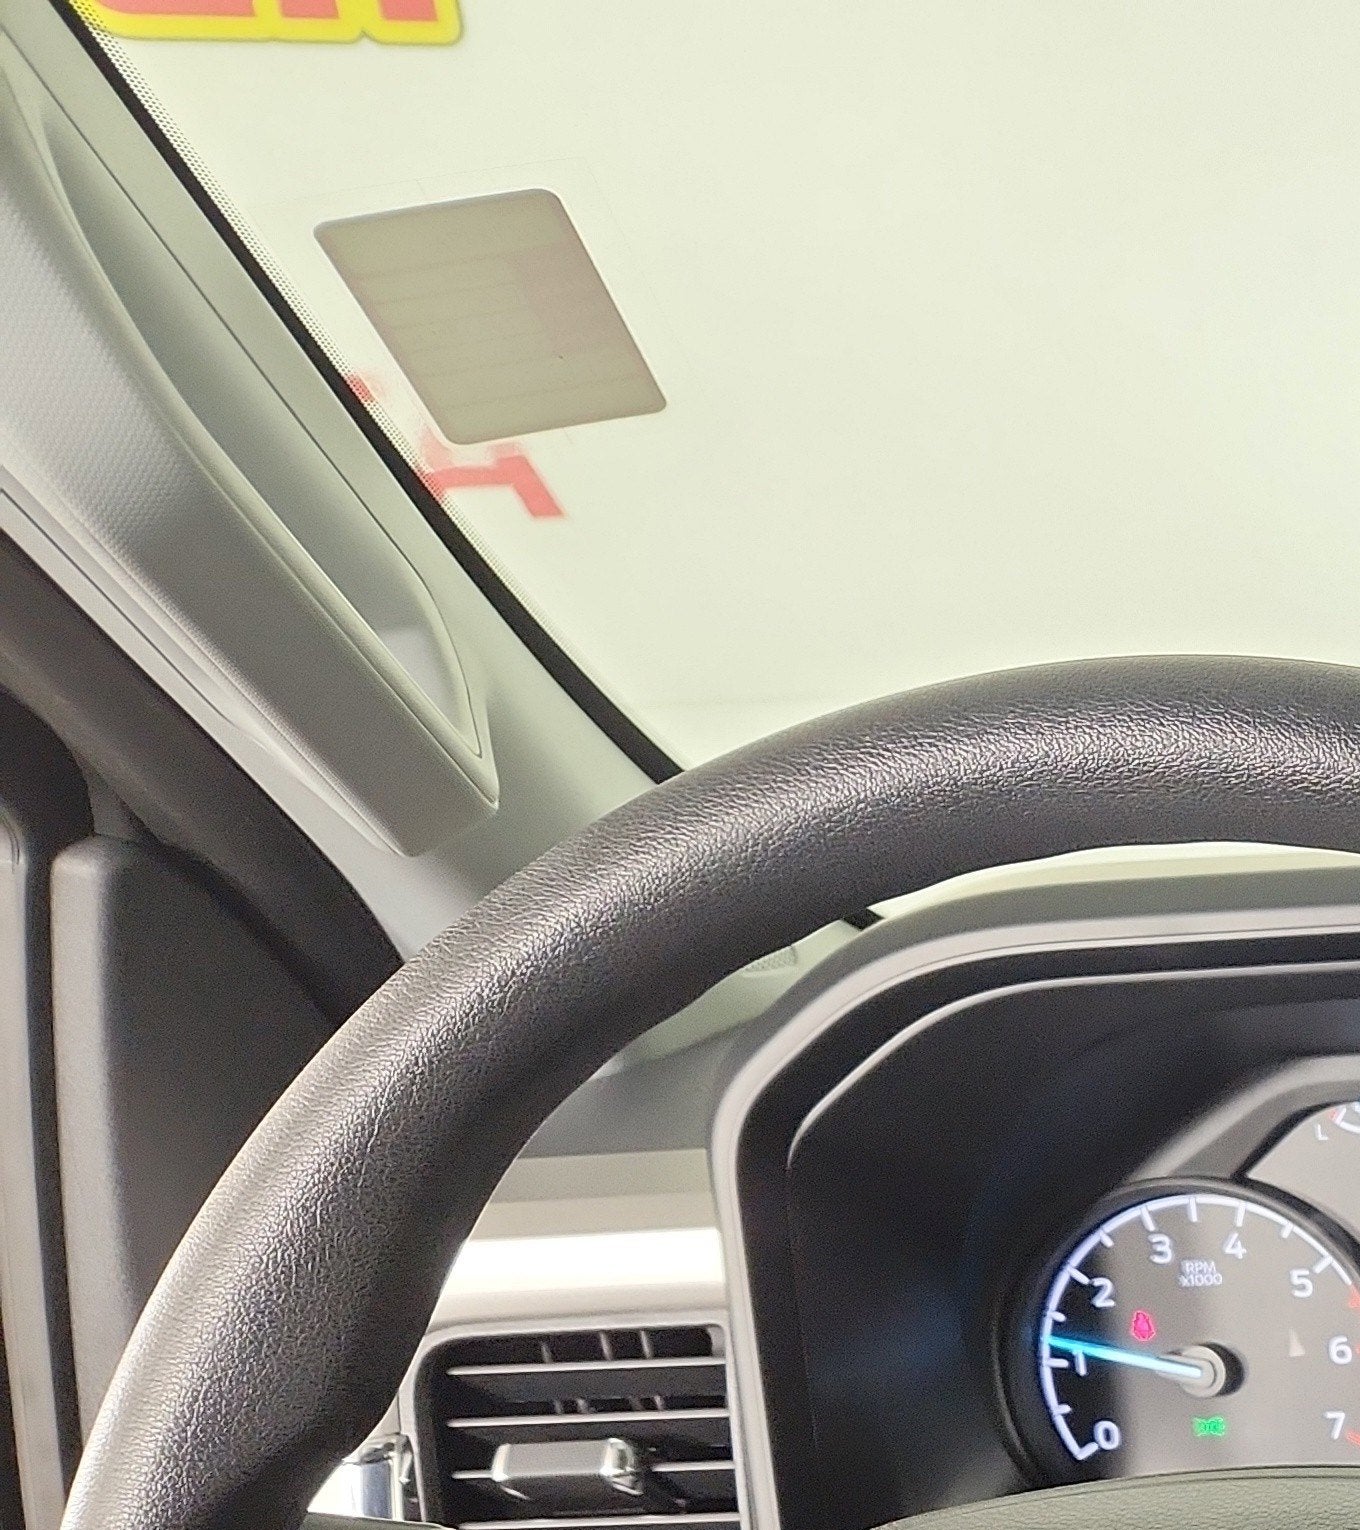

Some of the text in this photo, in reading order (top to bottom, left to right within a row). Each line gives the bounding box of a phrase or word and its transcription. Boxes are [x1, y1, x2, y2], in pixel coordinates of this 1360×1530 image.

[1315, 1124, 1329, 1141] L
[1148, 1233, 1174, 1264] 3
[1222, 1232, 1247, 1260] 4
[1181, 1260, 1218, 1275] RPM
[1088, 1277, 1115, 1308] 2
[1289, 1269, 1313, 1299] 5
[1328, 1335, 1354, 1365] 6
[1093, 1418, 1121, 1450] 0
[1324, 1411, 1346, 1440] 7
